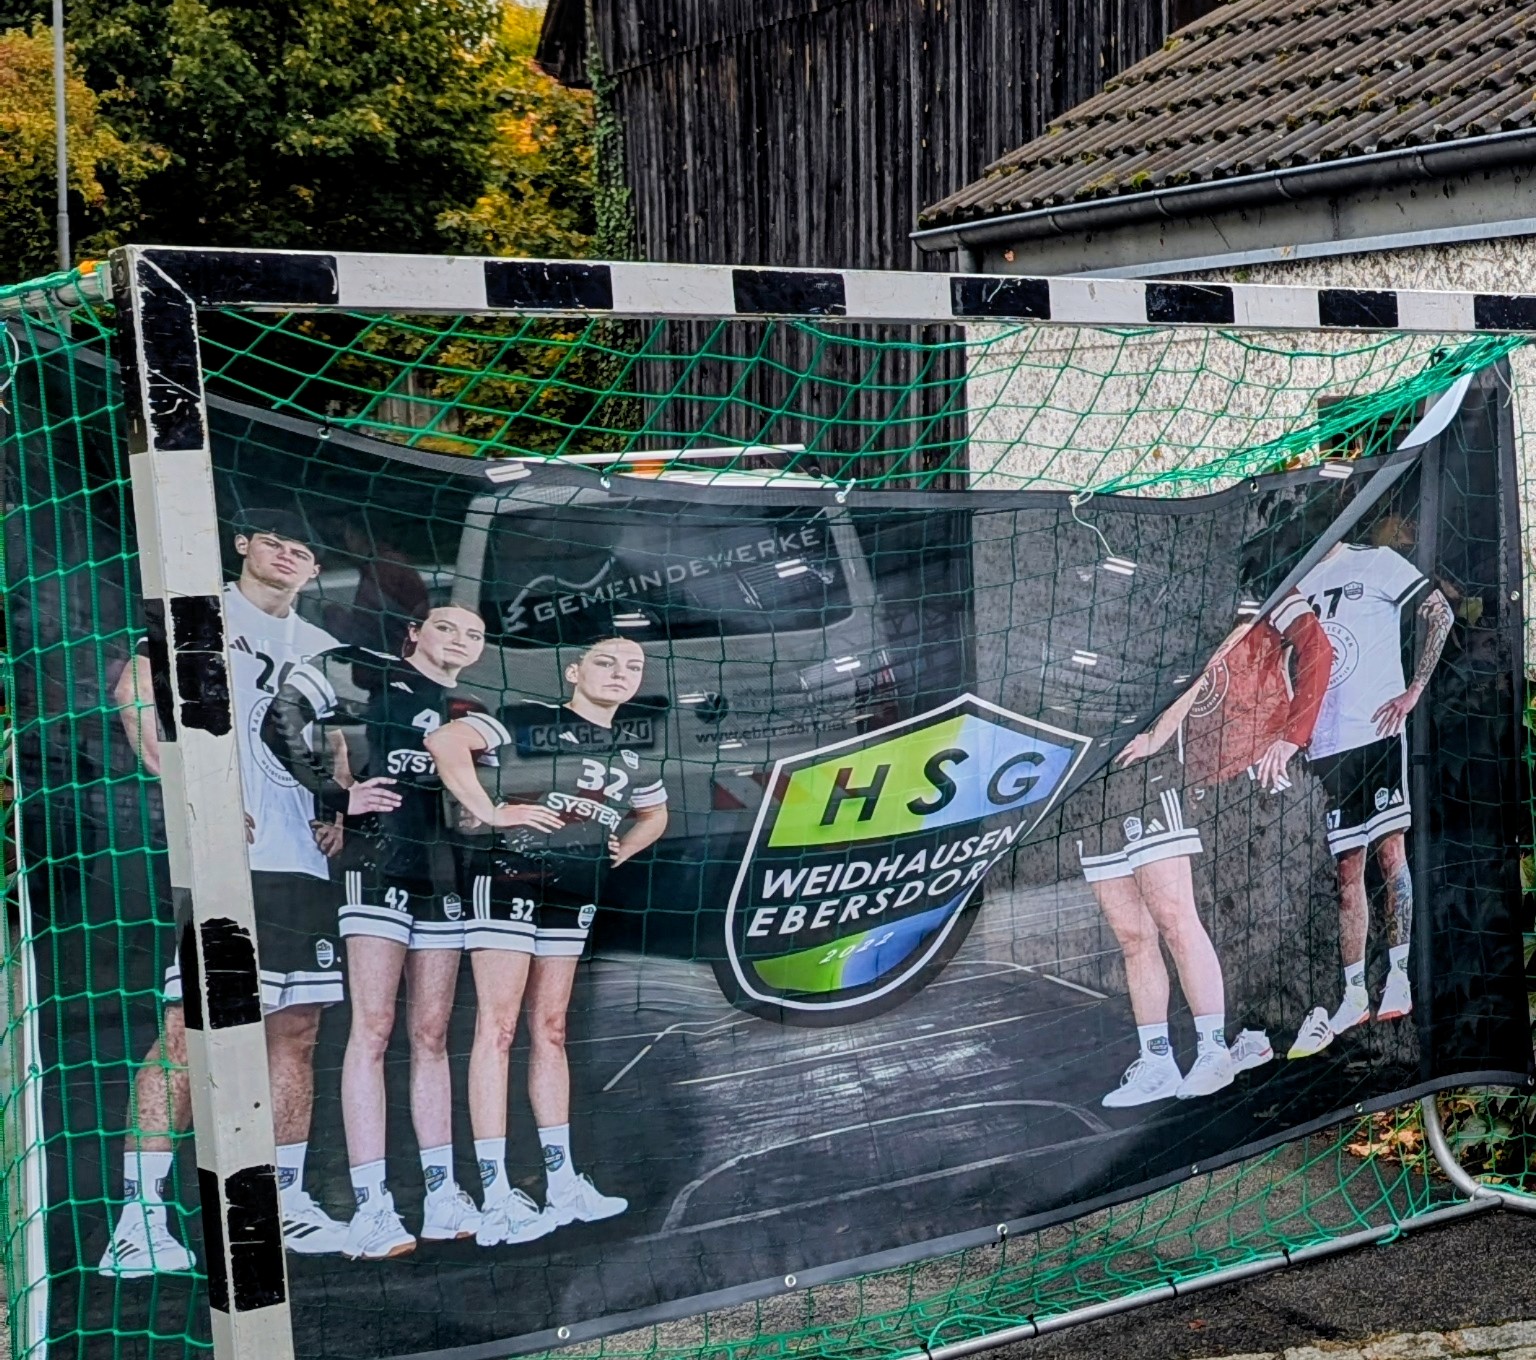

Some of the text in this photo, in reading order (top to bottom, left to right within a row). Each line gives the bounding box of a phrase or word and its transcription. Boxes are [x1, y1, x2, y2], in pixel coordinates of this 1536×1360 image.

[533, 527, 820, 622] GEMEINDEWERKE
[577, 758, 629, 802] 32
[819, 748, 1046, 827] HSG
[762, 820, 1027, 900] WEIDHAUSEN
[384, 886, 408, 913] 42
[510, 897, 535, 923] 32
[818, 931, 894, 964] 2022
